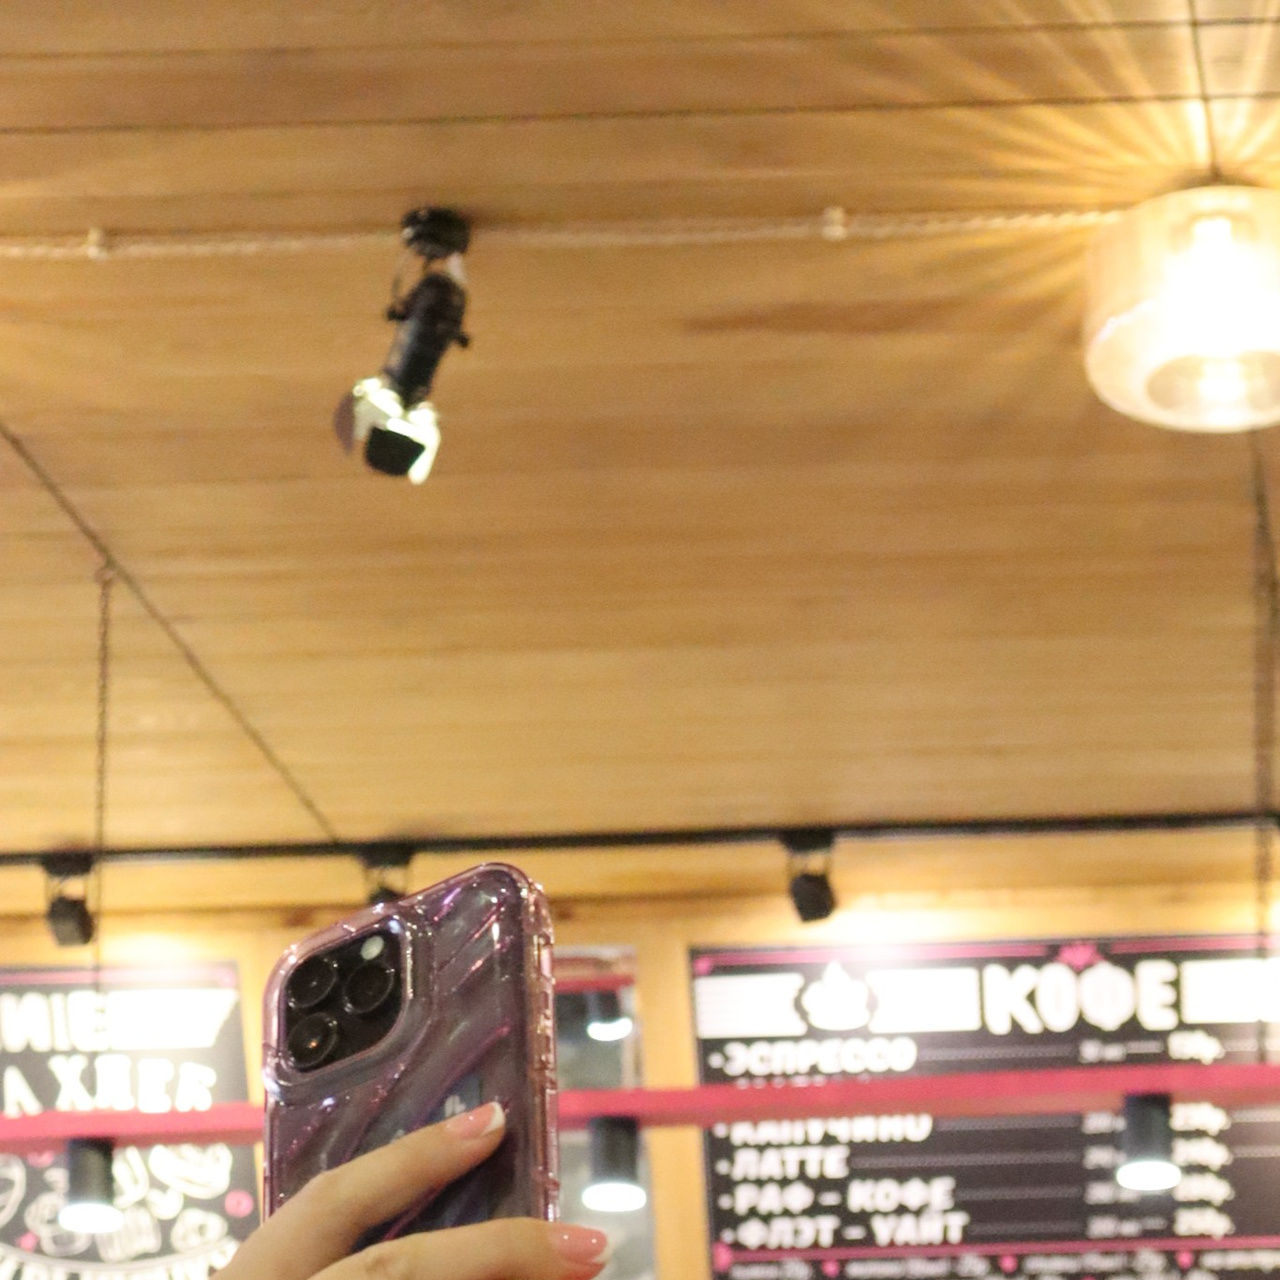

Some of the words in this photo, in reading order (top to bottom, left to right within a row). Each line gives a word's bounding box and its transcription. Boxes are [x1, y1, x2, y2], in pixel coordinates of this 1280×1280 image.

[982, 960, 1180, 1034] КОФЕ
[723, 1036, 918, 1077] ЭСПРЕССО
[731, 1144, 850, 1181] ЛАТТЕ
[733, 1181, 815, 1216] РАФ
[847, 1176, 956, 1213] КОФЕ
